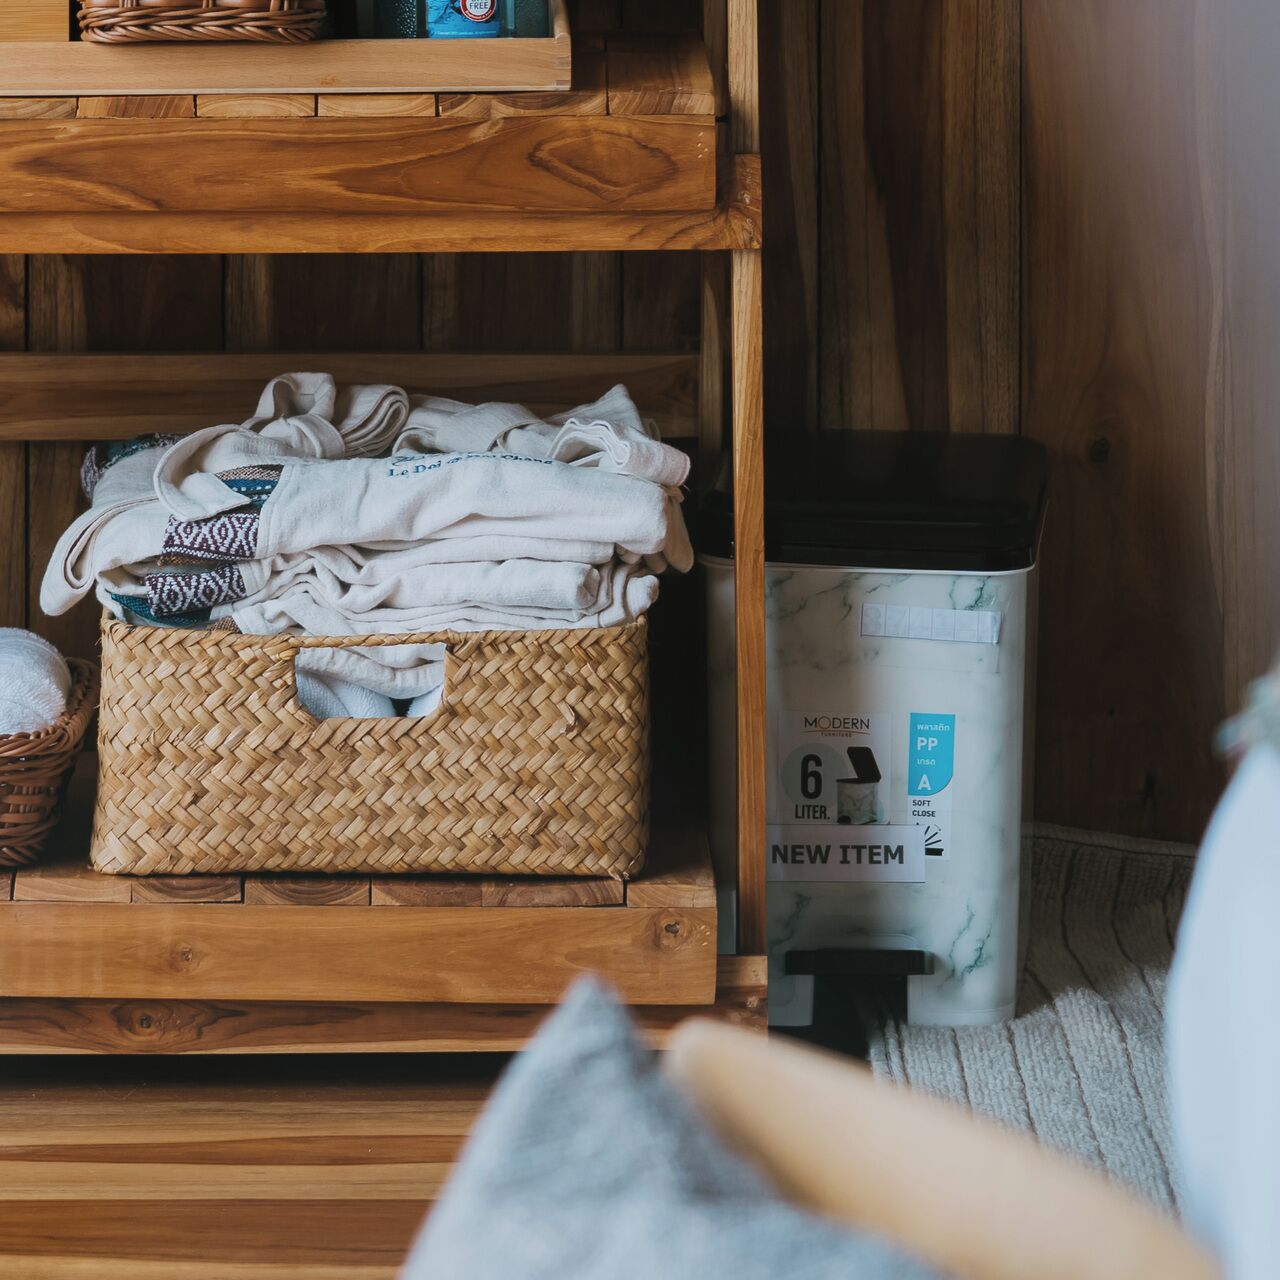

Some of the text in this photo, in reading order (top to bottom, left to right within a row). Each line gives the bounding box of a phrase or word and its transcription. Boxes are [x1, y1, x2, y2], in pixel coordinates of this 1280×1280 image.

[469, 2, 489, 10] FREE
[414, 460, 442, 474] Doi
[804, 716, 870, 730] MODERN
[916, 723, 951, 732] พลาสติก
[916, 736, 939, 751] PP
[916, 758, 936, 766] เกรด
[800, 753, 823, 800] 6
[917, 774, 932, 791] A
[912, 799, 932, 807] SOFT
[795, 804, 831, 820] LITER.
[912, 809, 937, 818] CLOSE
[771, 844, 905, 865] NEW ITEM
